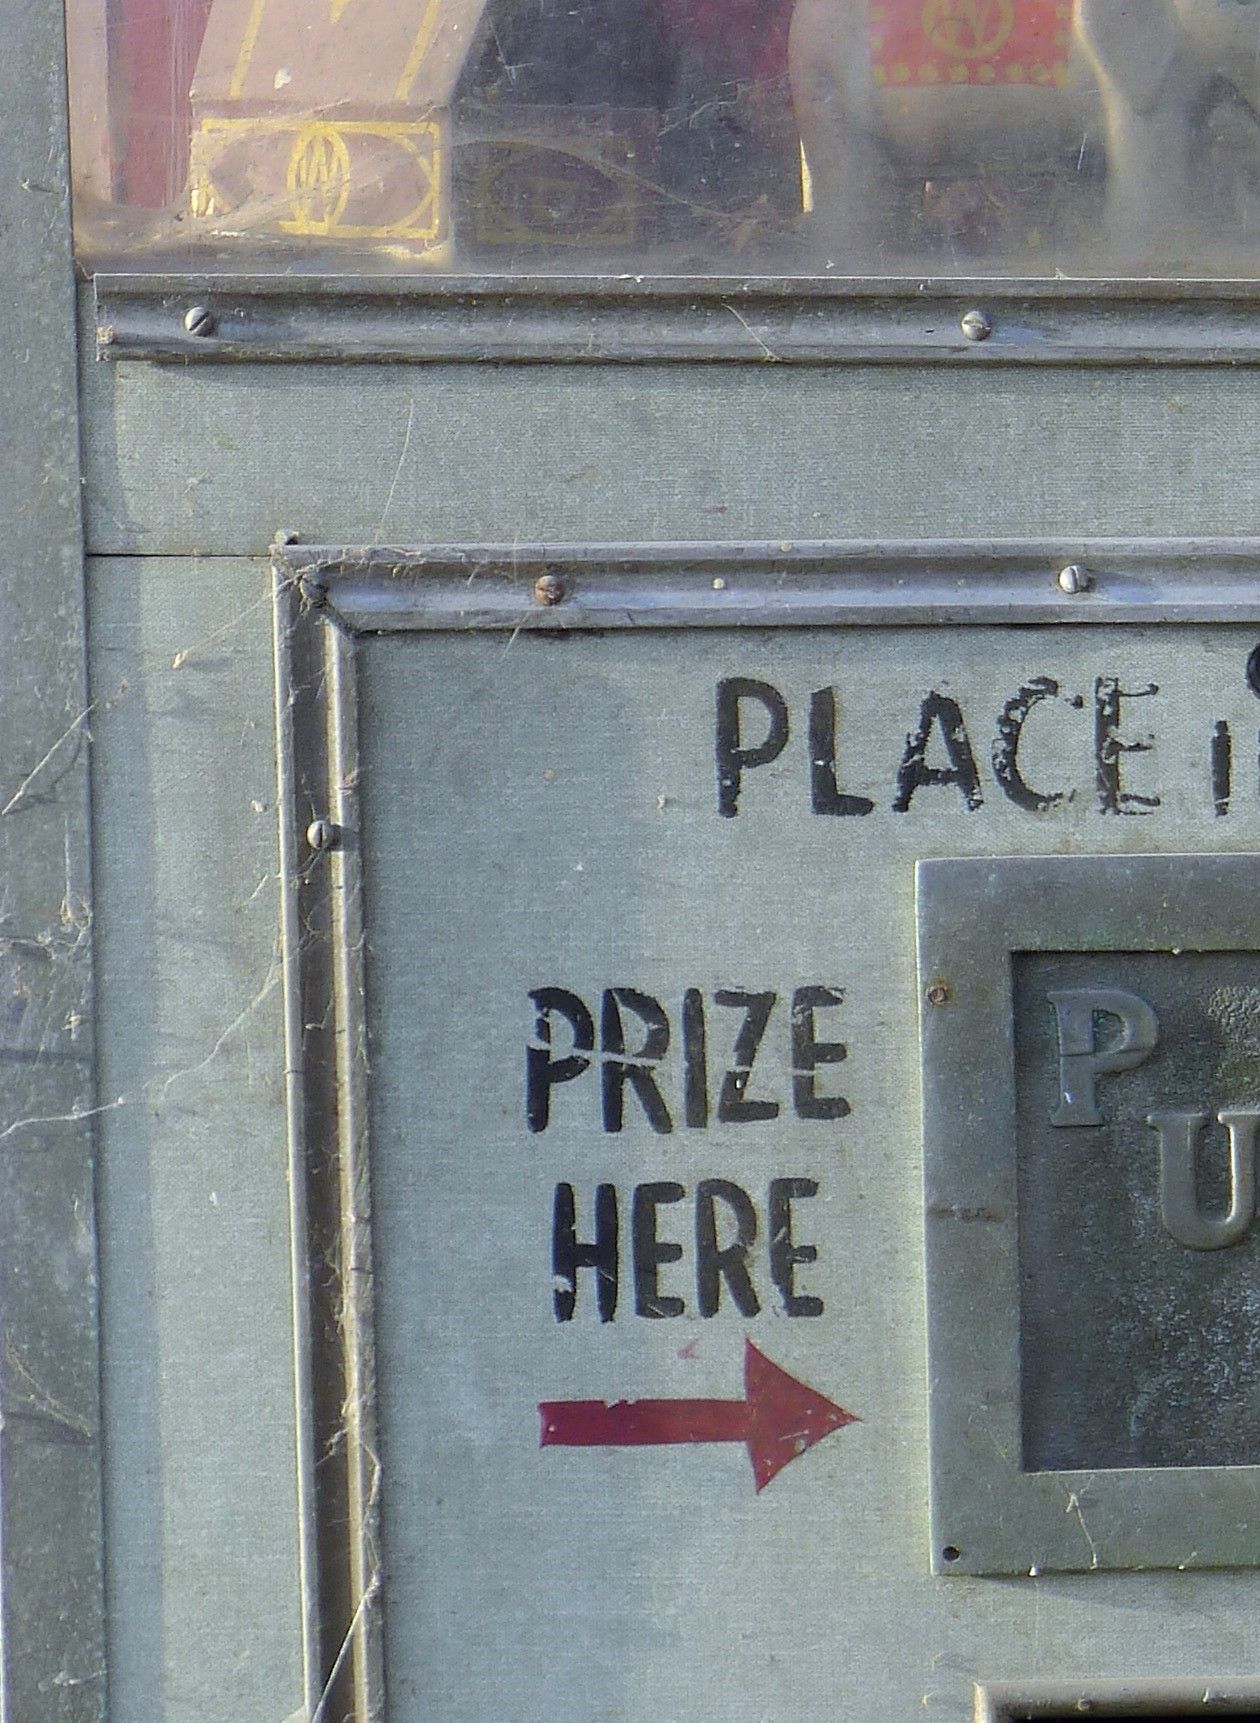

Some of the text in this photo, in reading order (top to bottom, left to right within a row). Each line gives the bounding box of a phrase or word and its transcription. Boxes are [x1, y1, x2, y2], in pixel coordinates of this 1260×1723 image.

[716, 676, 1161, 817] PLACE
[526, 985, 852, 1134] PRIZE
[551, 1177, 825, 1323] HERE
